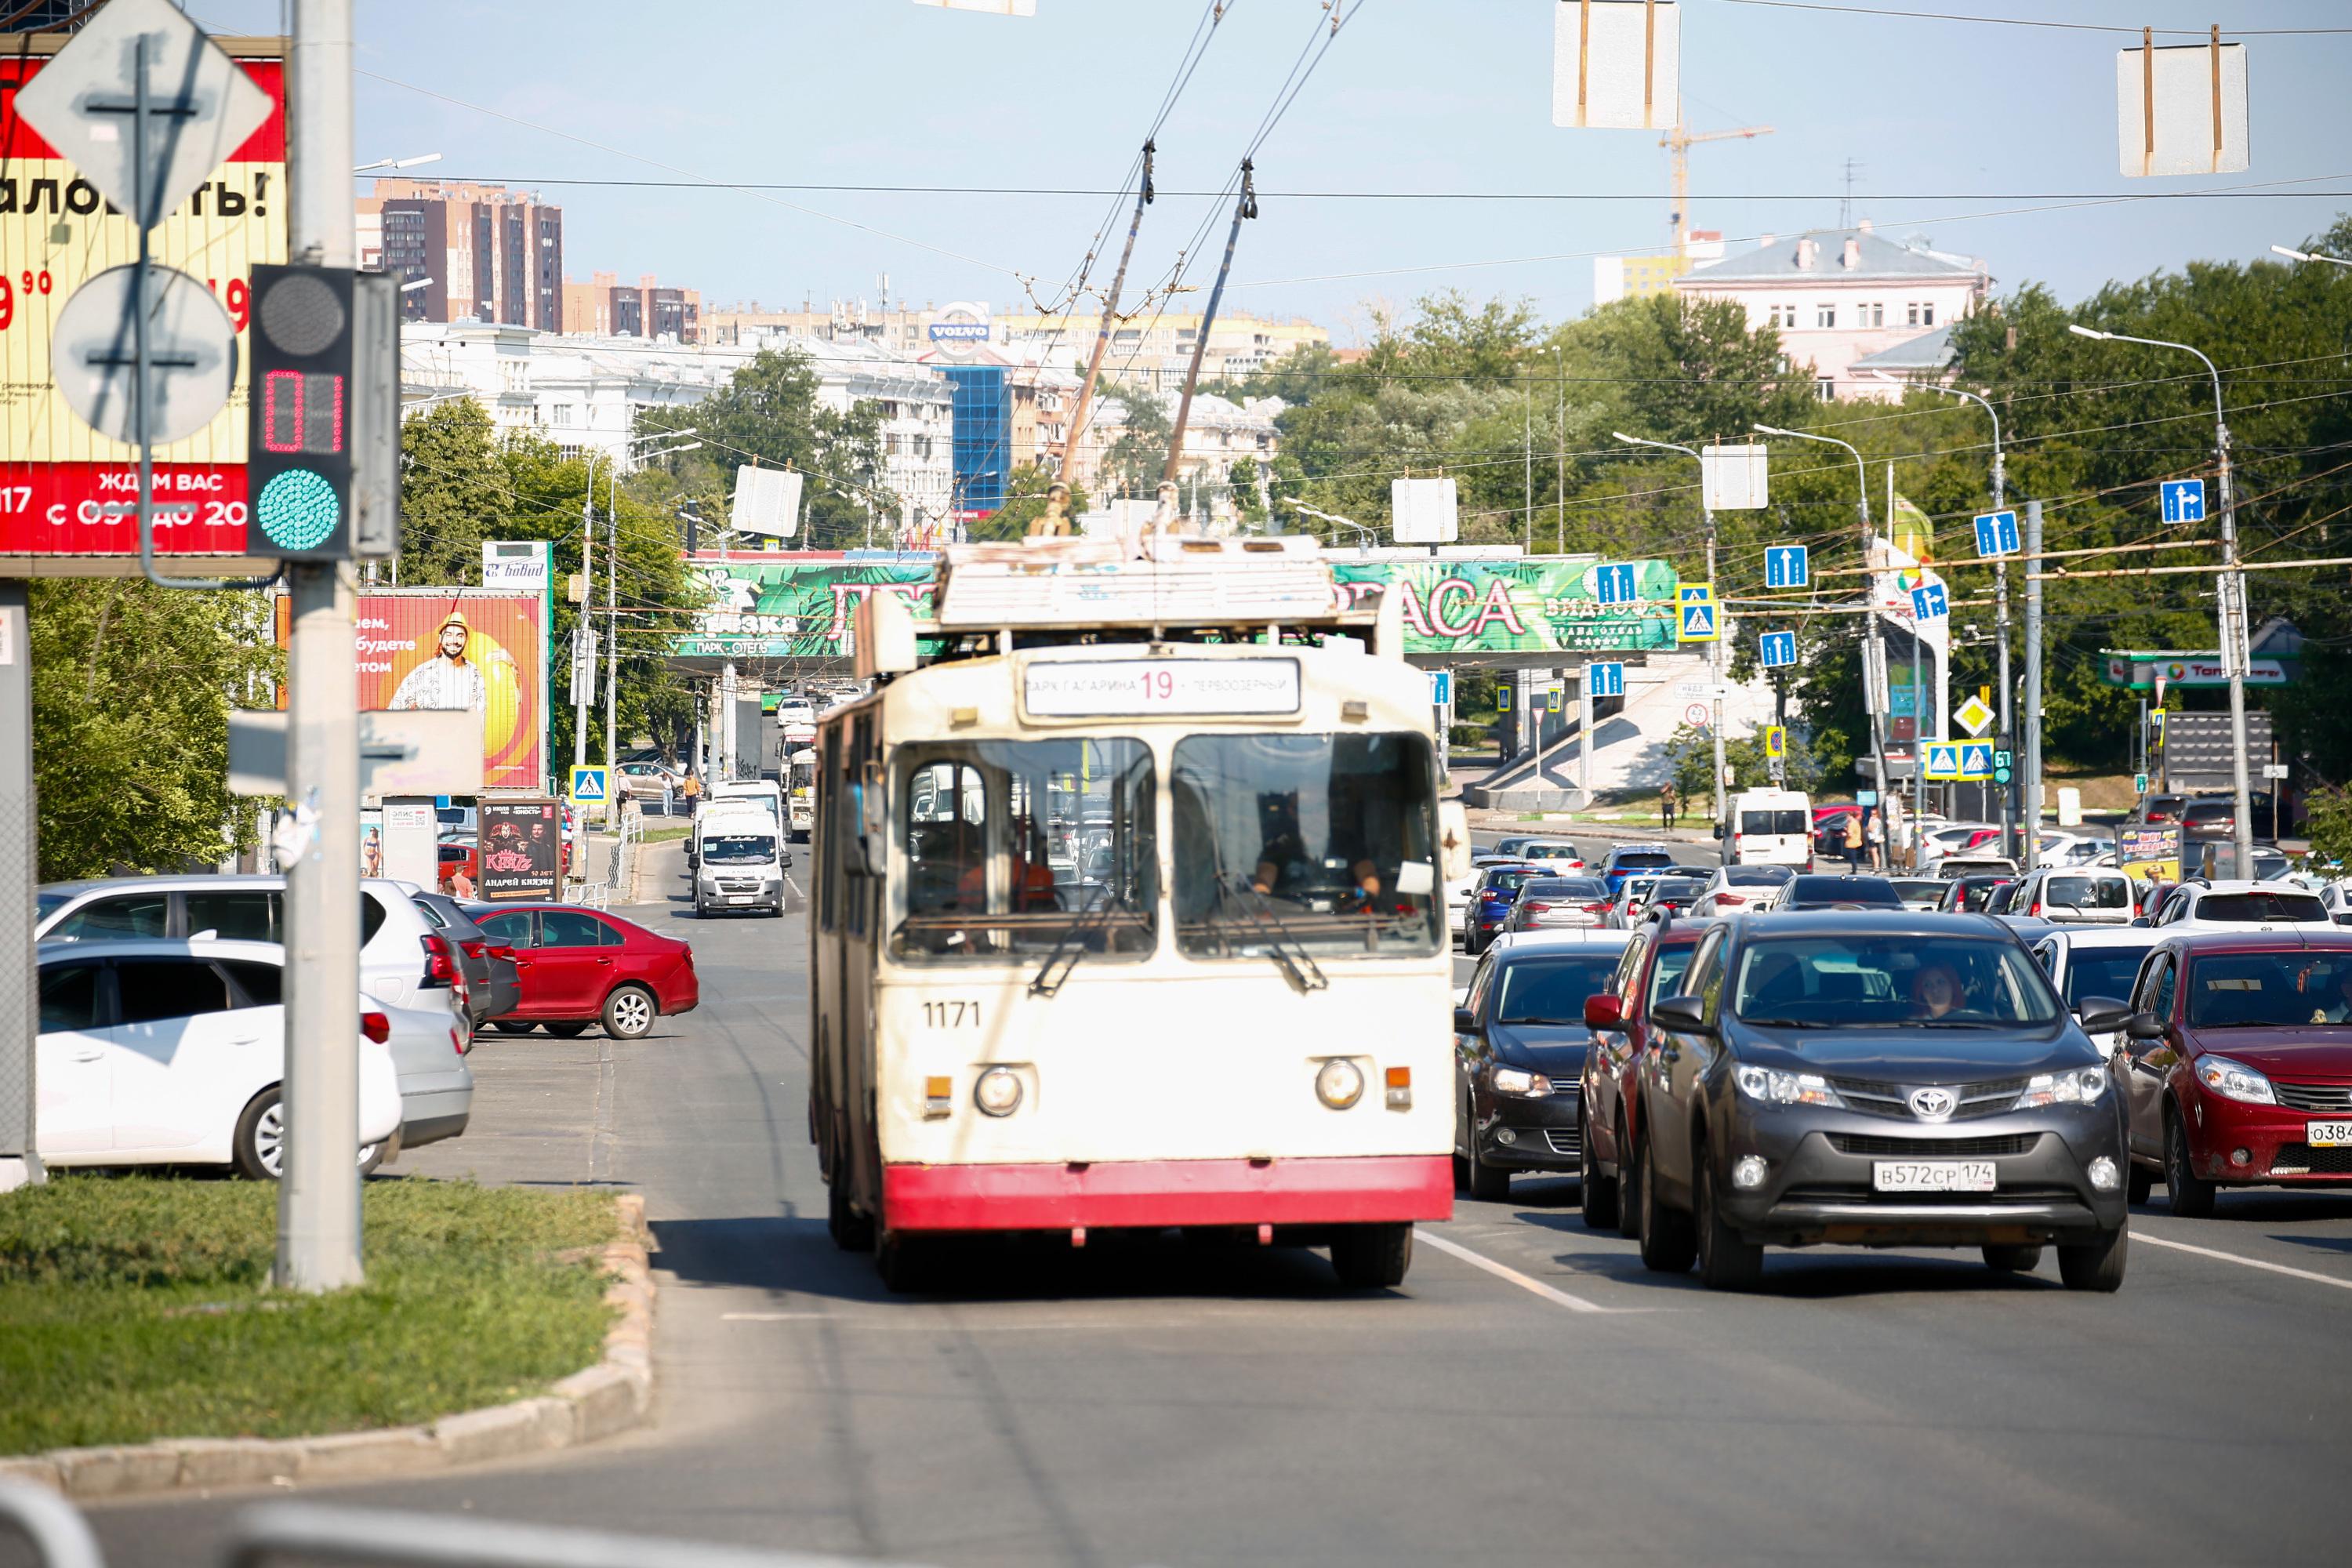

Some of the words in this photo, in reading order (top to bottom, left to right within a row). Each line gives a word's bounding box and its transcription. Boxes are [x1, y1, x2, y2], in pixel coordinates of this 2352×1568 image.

[22, 270, 52, 295] 90
[931, 326, 987, 337] VOLVO
[99, 473, 171, 492] ЖДМ
[176, 474, 224, 492] ВАС
[0, 485, 32, 514] 17
[355, 635, 416, 655] будете
[696, 642, 724, 654] ПАРК
[731, 642, 768, 654] ОТЕЛЬ
[1141, 670, 1174, 699] 19
[485, 806, 492, 815] 9
[922, 1001, 979, 1027] 1171
[1962, 1164, 1991, 1178] 174
